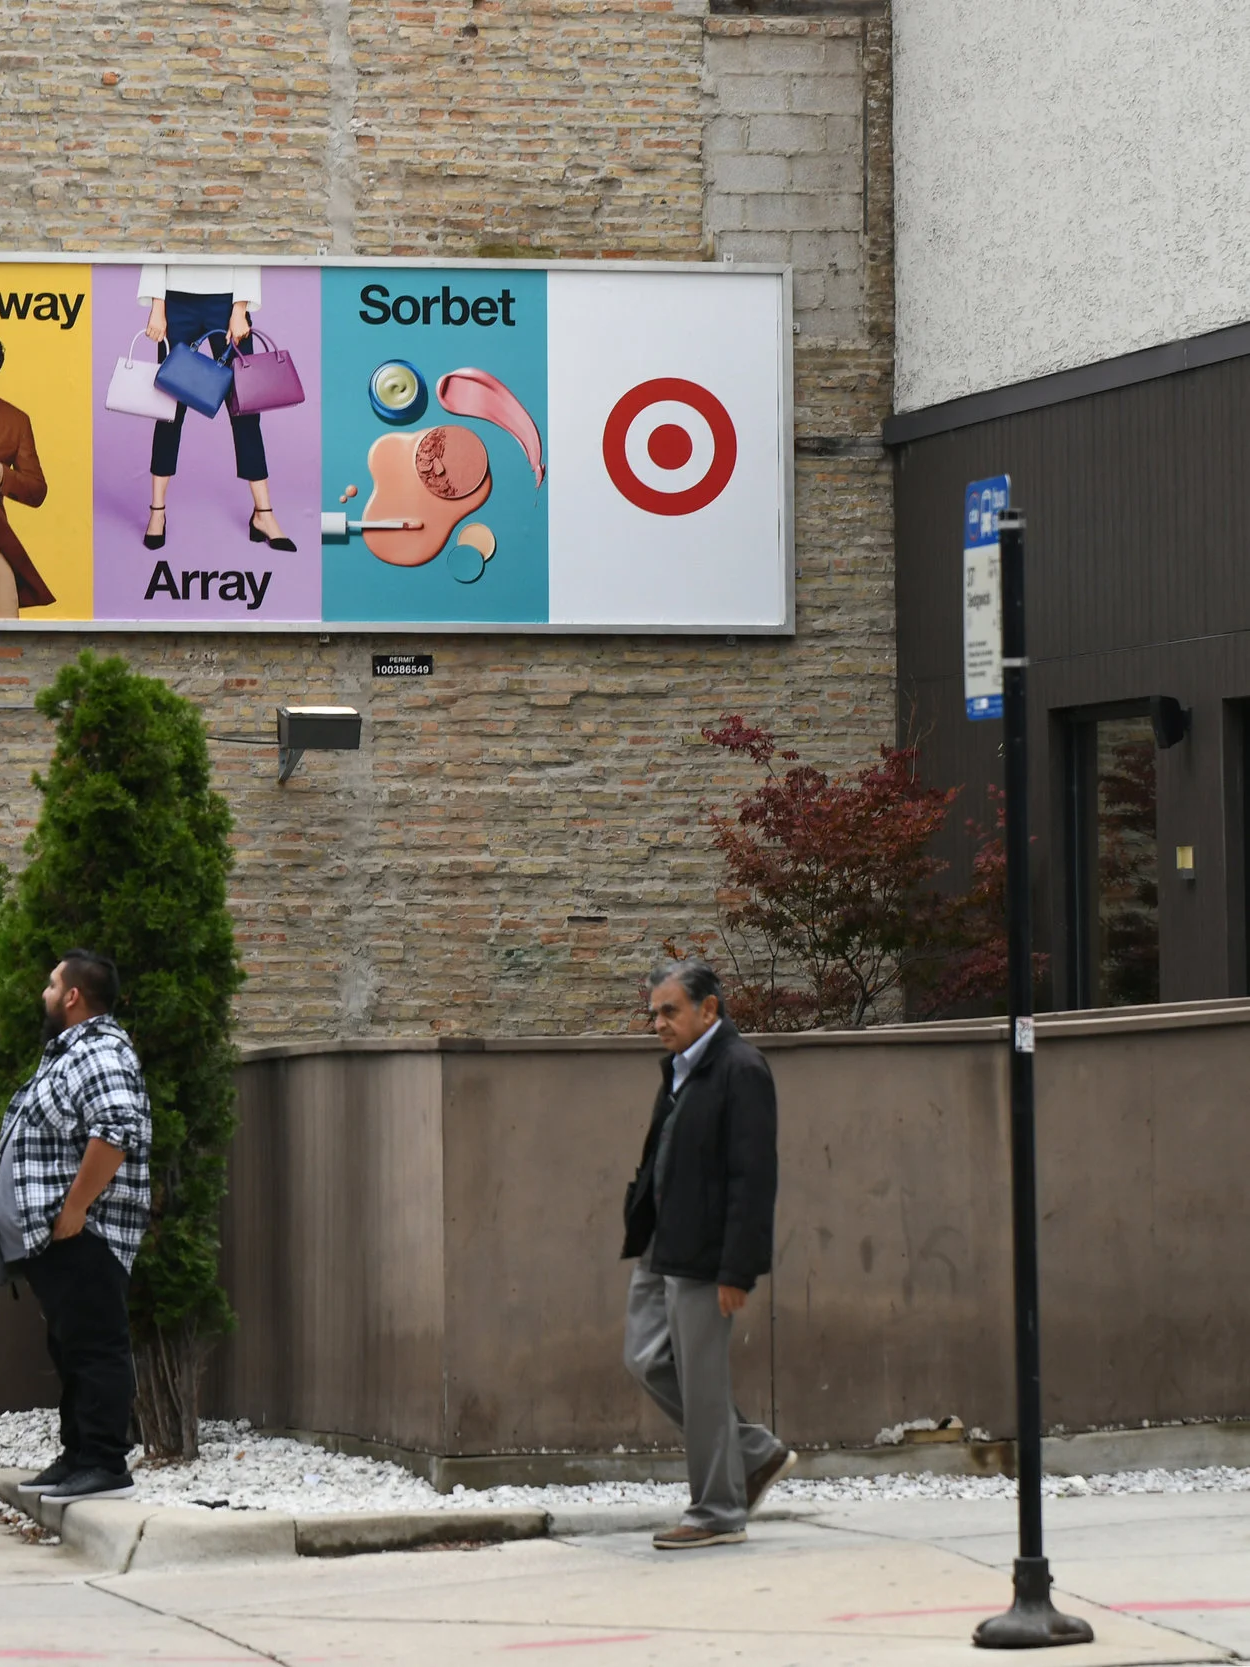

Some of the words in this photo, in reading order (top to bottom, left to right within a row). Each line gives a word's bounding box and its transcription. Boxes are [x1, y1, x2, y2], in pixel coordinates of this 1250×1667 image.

[359, 284, 516, 327] Sorbet
[144, 560, 272, 610] Array
[376, 665, 429, 675] 100386549
